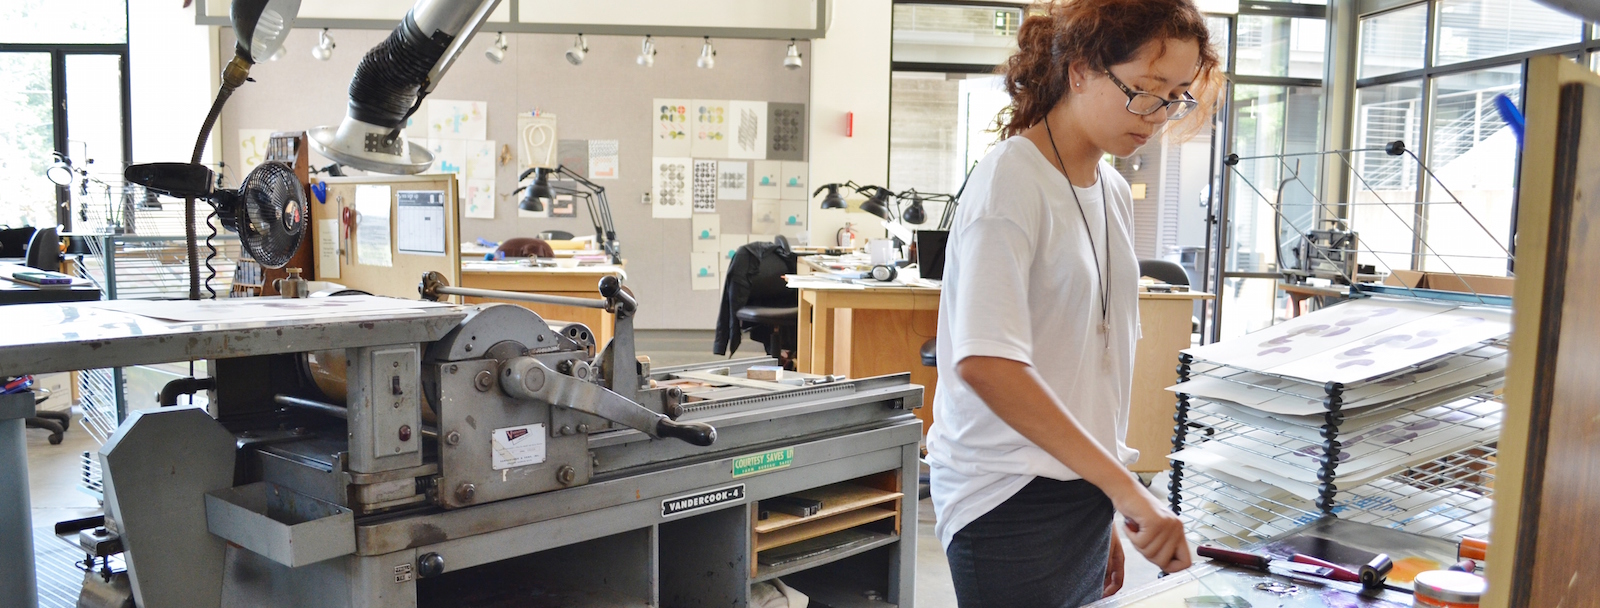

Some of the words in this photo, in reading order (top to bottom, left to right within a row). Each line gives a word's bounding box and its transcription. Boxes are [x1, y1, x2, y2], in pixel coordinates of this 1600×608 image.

[735, 454, 764, 469] COURTESY
[766, 451, 784, 463] SAVES
[669, 489, 738, 511] VANDERCOOK-4
